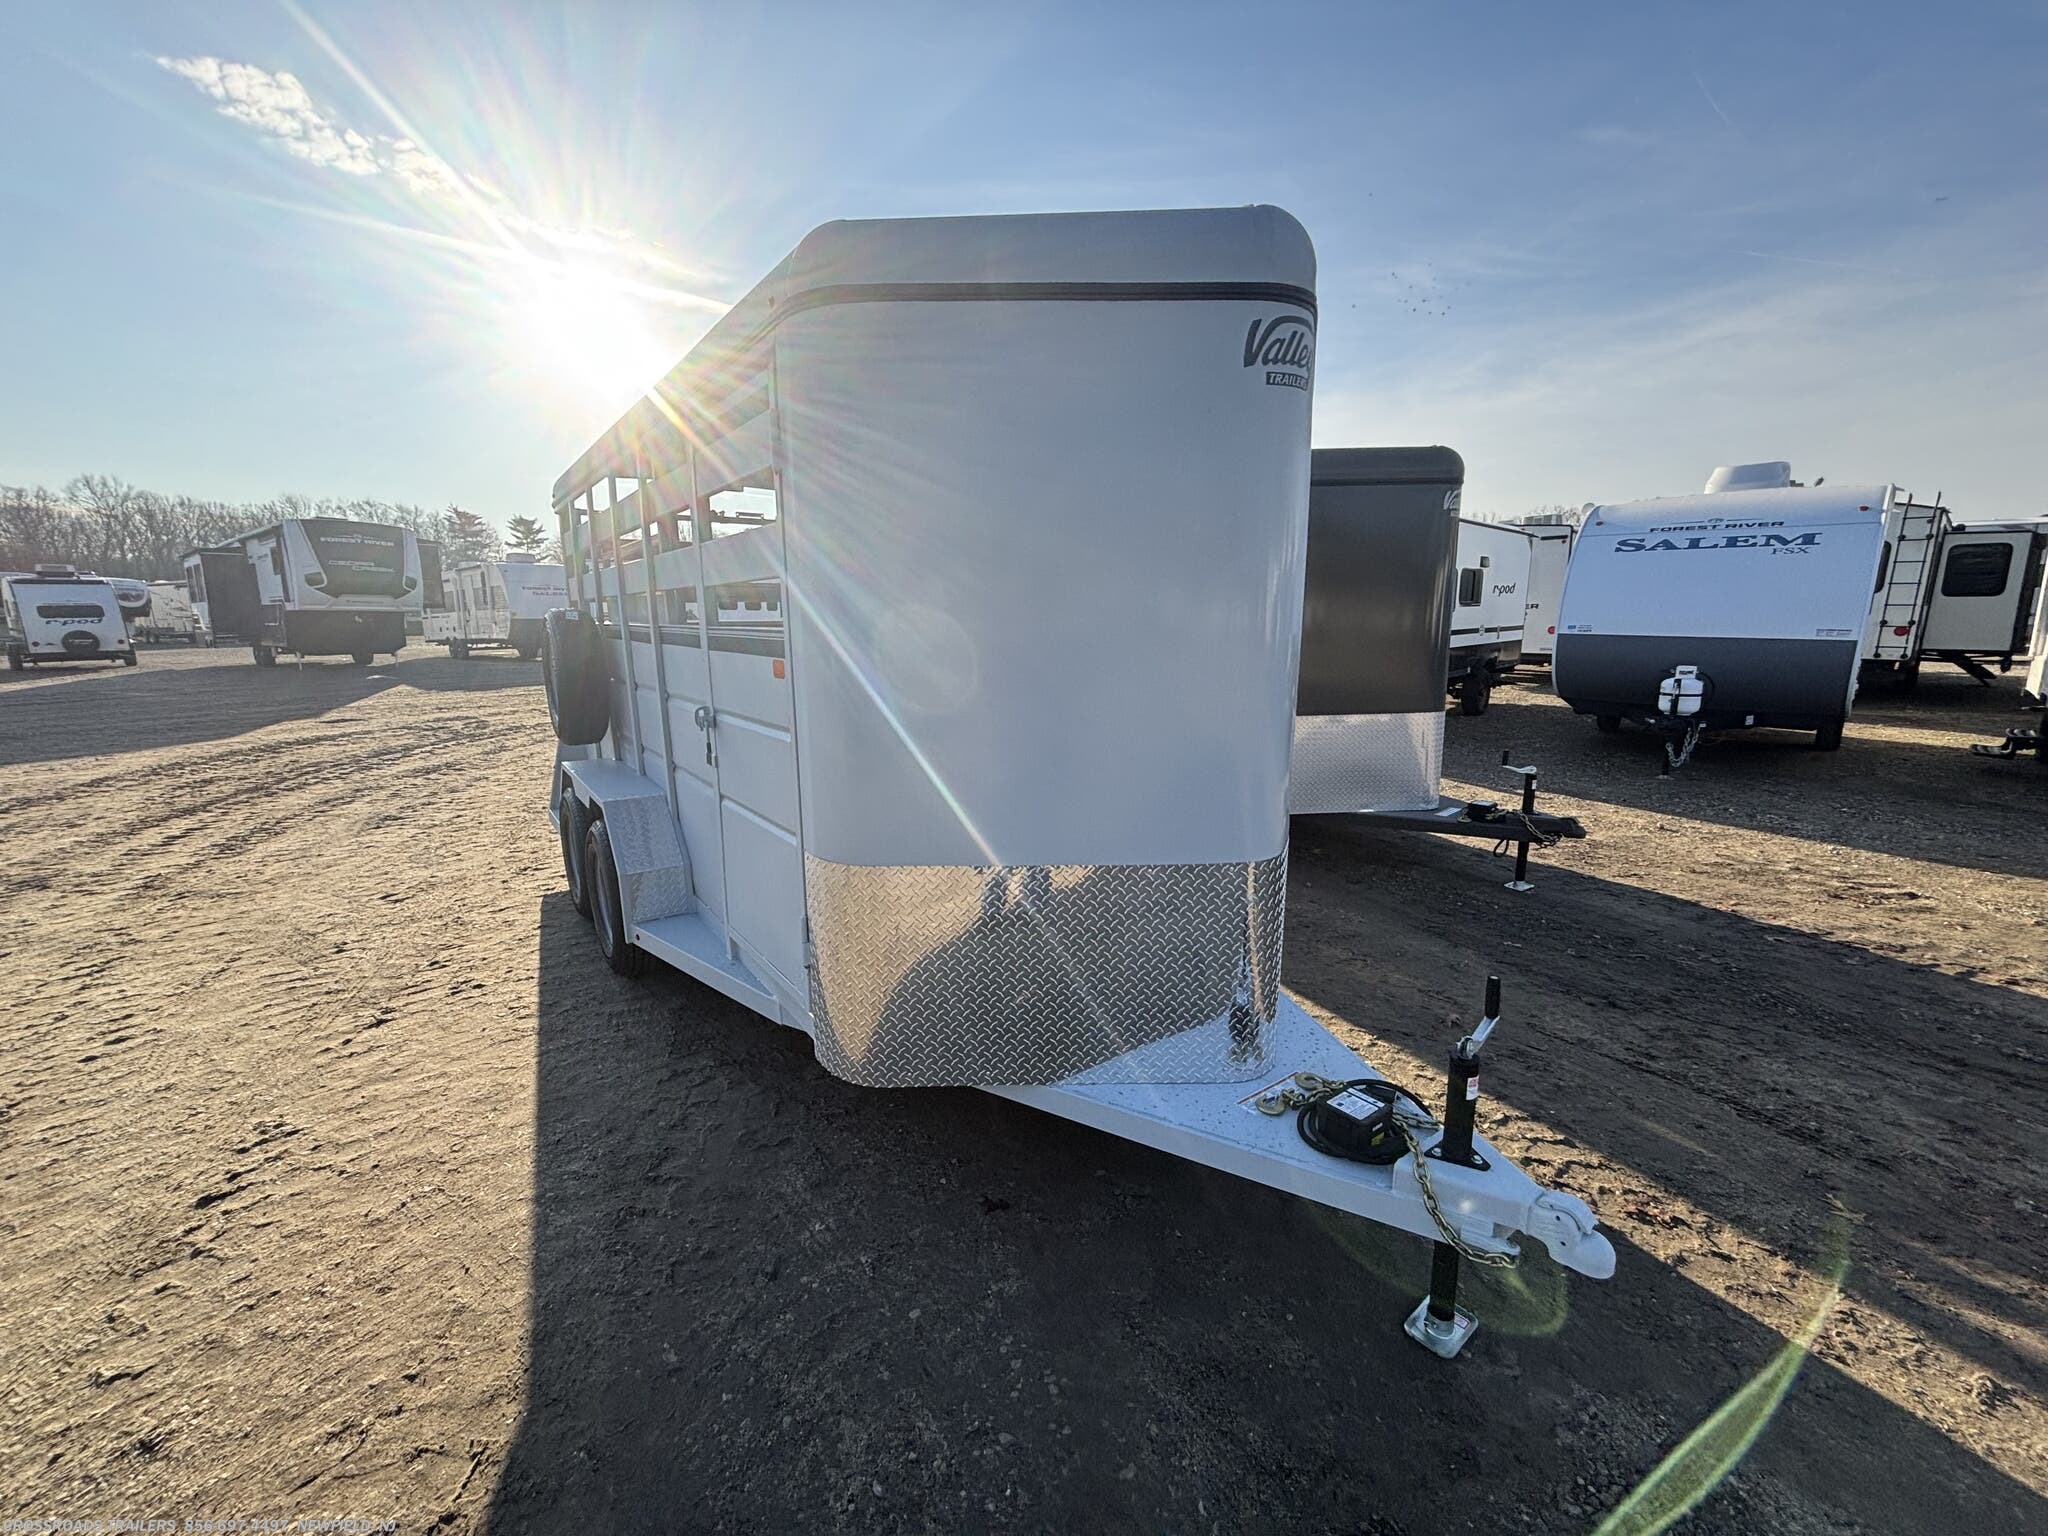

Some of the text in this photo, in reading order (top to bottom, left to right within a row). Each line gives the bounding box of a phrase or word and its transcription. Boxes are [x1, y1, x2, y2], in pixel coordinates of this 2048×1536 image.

[1650, 520, 1785, 533] FOREST RIVER
[1614, 532, 1824, 553] SALEM
[1771, 546, 1810, 555] FSX
